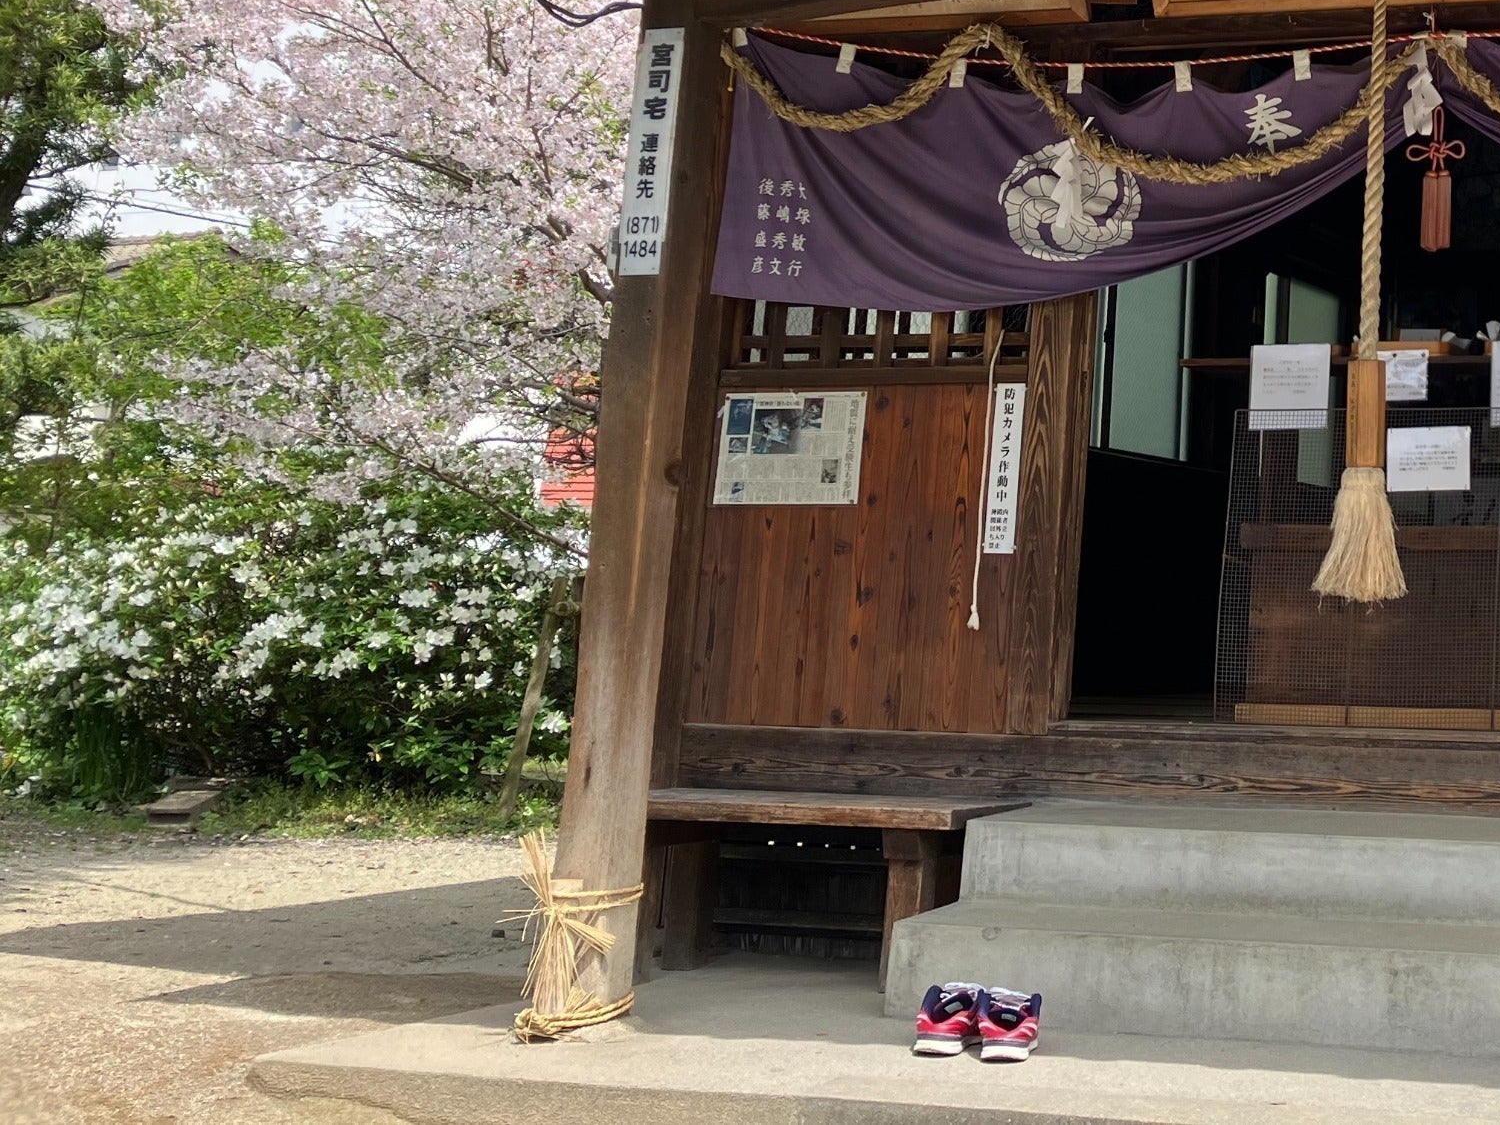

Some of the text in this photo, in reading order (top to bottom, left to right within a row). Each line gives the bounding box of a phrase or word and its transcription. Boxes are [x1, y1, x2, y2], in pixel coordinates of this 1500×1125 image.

[635, 43, 675, 200] 宮司宅 連絡先
[1243, 93, 1302, 153] 奉
[623, 239, 657, 258] 1484
[626, 215, 660, 235] (871)
[996, 387, 1016, 503] 防犯カメラ作動中
